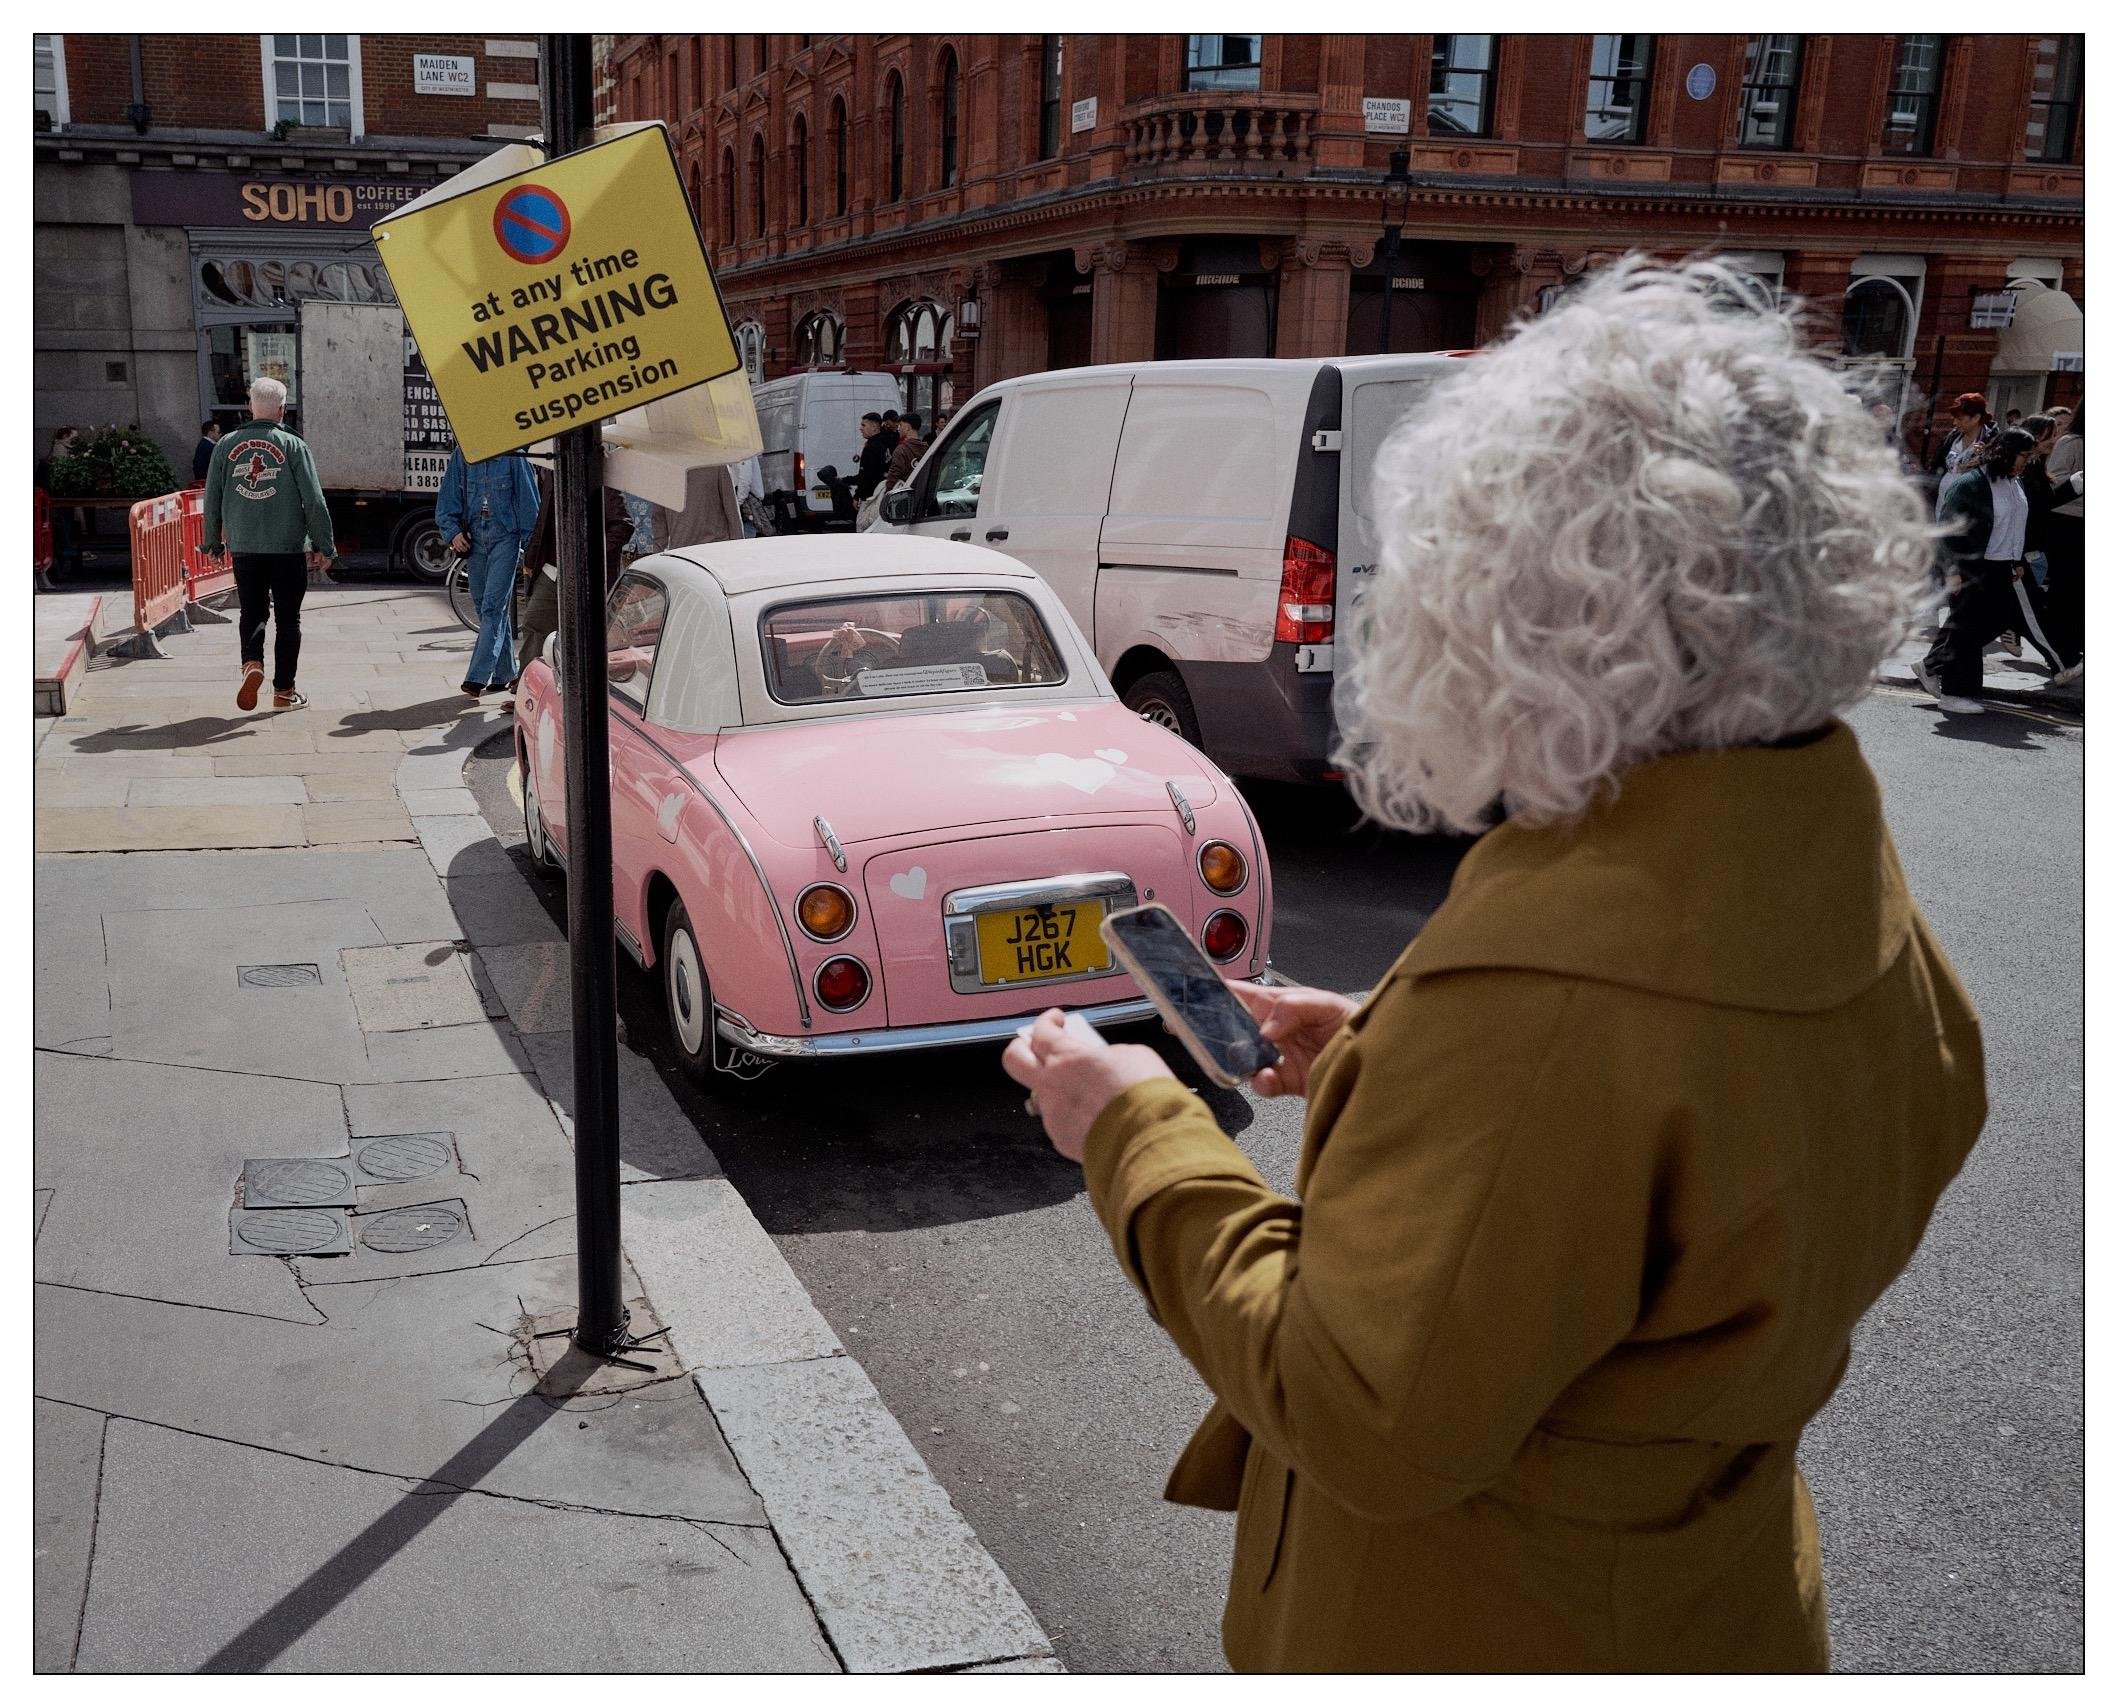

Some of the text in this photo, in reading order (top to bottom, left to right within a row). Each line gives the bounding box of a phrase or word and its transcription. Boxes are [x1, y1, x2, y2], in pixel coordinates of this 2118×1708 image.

[420, 58, 458, 70] MAIDEN
[420, 71, 469, 82] LANE WC2
[1366, 101, 1401, 112] CHANDOS
[1365, 112, 1406, 122] PLACE WC2
[356, 186, 414, 201] COFFEE
[242, 181, 354, 223] SOHO
[357, 202, 396, 210] est 1999
[471, 249, 640, 323] at any time
[1391, 277, 1425, 289] RCADE
[461, 272, 679, 375] WARNING
[526, 335, 642, 389] Parking
[404, 386, 438, 400] ENCE
[514, 357, 679, 431] suspension
[404, 457, 450, 471] LEARA
[1006, 909, 1076, 944] J267
[1017, 940, 1073, 974] HGK
